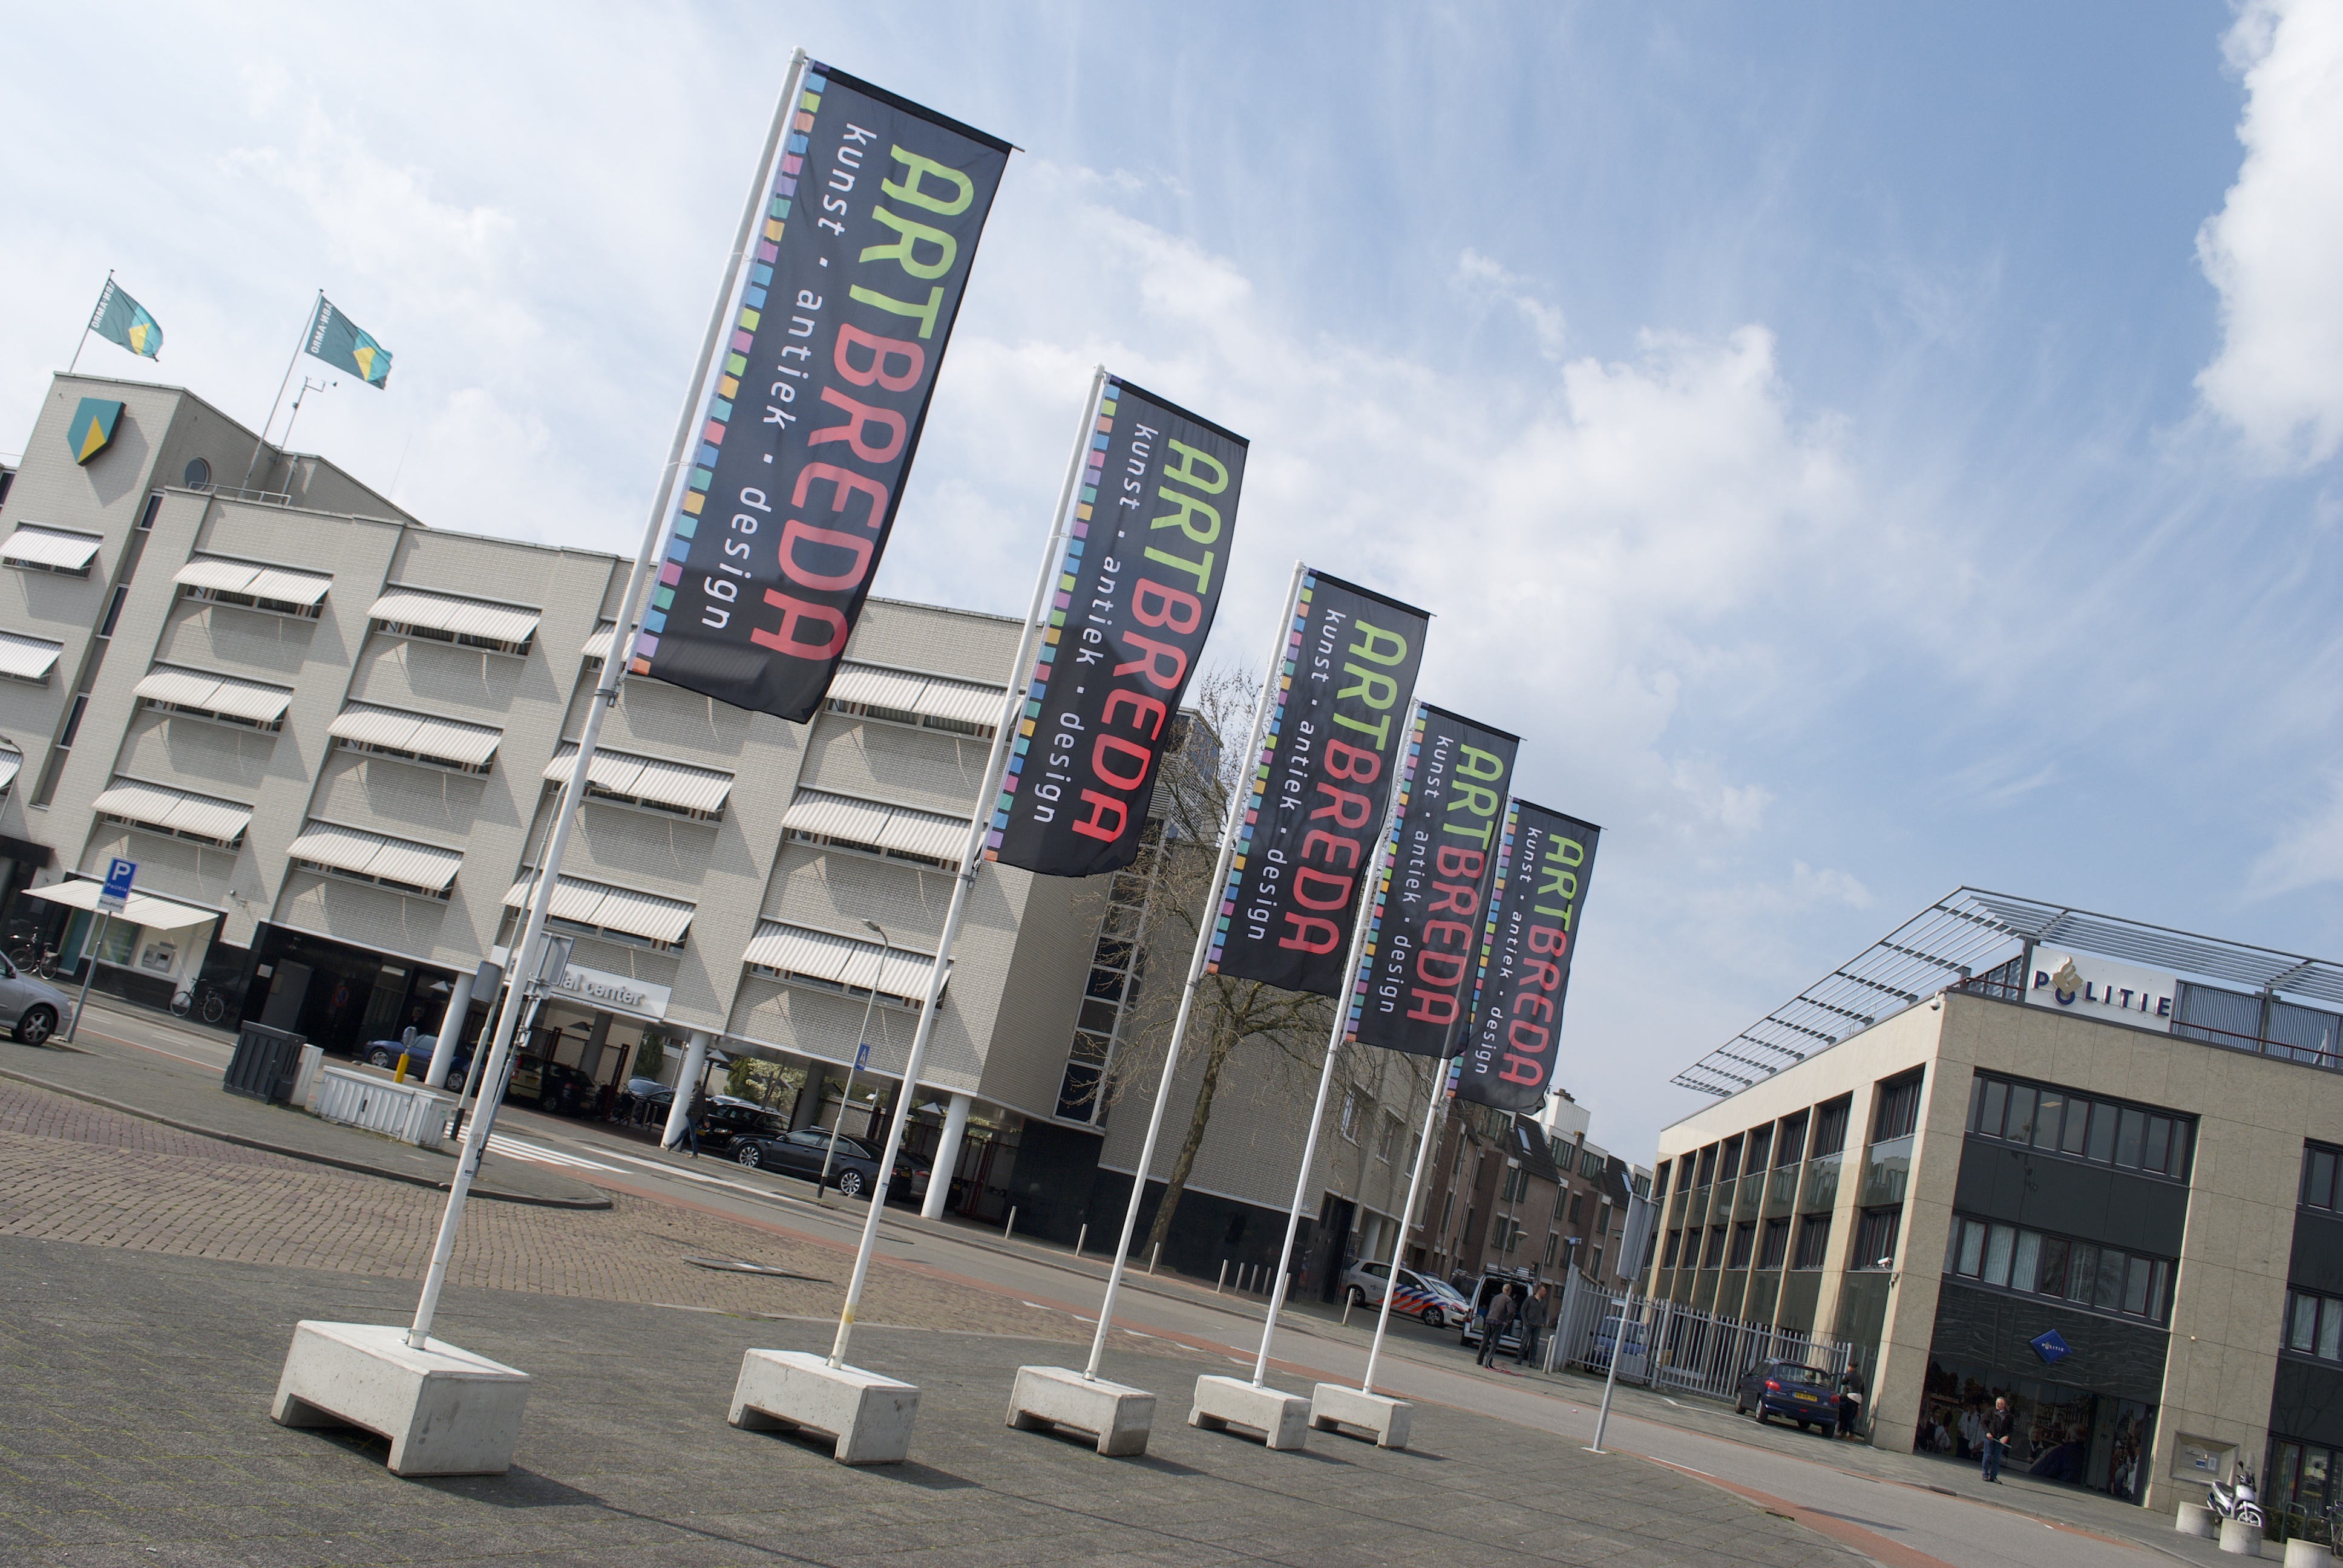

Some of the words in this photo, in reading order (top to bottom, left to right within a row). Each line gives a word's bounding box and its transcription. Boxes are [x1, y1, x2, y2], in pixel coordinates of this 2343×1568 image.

[817, 122, 878, 237] kunst
[750, 143, 974, 661] ARTBREDA
[762, 289, 823, 431] antiek
[1118, 422, 1159, 511] kunst
[701, 486, 773, 630] design
[1072, 437, 1229, 844] ARTBREDA
[1075, 555, 1122, 666] antiek
[1310, 608, 1347, 684] kunst
[1033, 711, 1086, 823] design
[1278, 619, 1407, 956] ARTBREDA
[1279, 720, 1315, 811] antiek
[1423, 734, 1455, 799] kunst
[112, 861, 131, 881] P
[1247, 848, 1288, 940] design
[1402, 830, 1429, 904] antiek
[1406, 743, 1504, 1025] ARTBREDA
[1519, 826, 1543, 884] kunst
[1378, 935, 1412, 1013] design
[1498, 833, 1584, 1088] ARTBREDA
[1499, 910, 1522, 979] antiek
[586, 981, 644, 1005] center
[2031, 970, 2171, 1018] POLITIE
[1474, 1006, 1504, 1074] design
